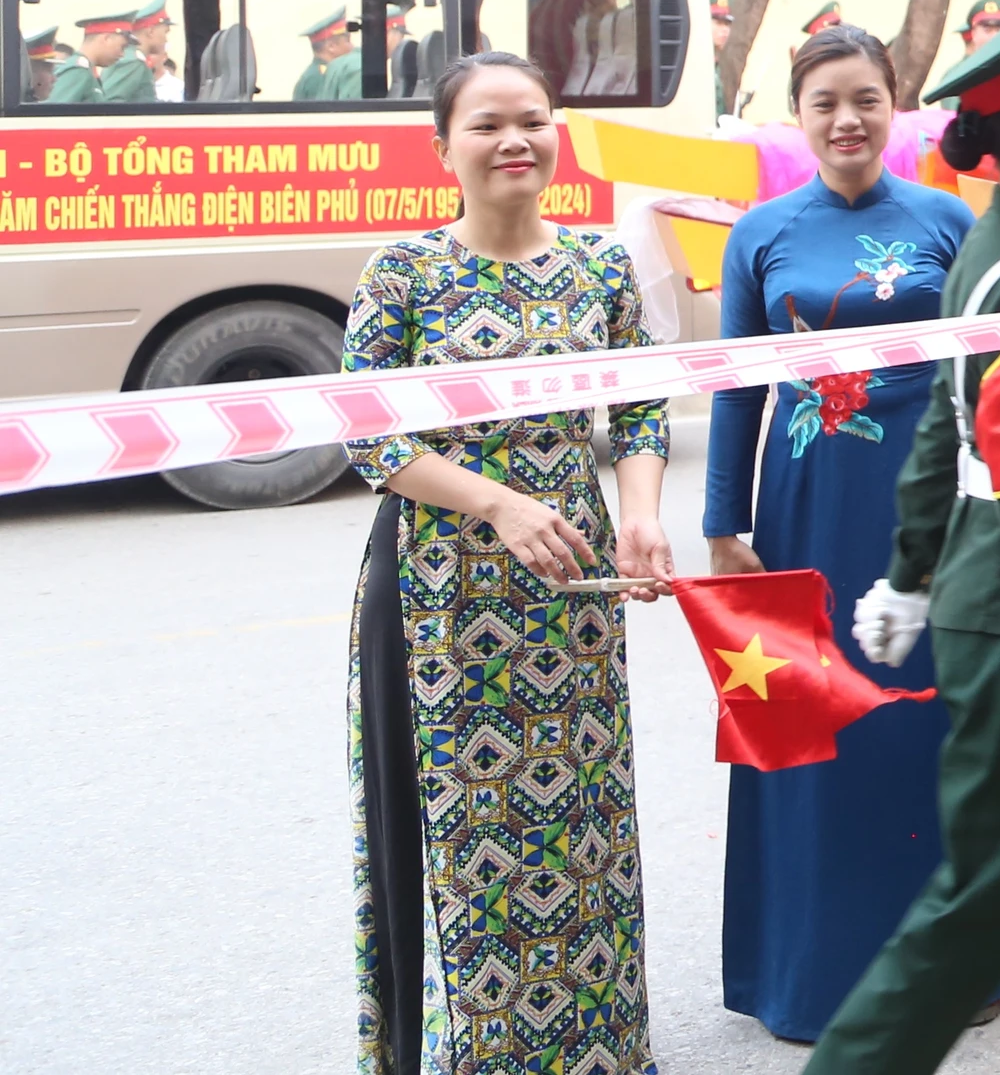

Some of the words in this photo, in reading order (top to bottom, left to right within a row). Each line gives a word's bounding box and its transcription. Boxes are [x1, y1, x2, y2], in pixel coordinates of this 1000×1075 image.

[45, 142, 92, 183] BỘ
[103, 136, 194, 176] TỔNG
[204, 144, 297, 174] THAM
[308, 140, 380, 172] MƯU
[0, 190, 37, 232] ĂM
[45, 184, 115, 230] CHIẾN
[121, 181, 196, 228] THẮNG
[202, 184, 254, 233] ĐIỆN
[260, 183, 310, 224] BIÊN
[316, 178, 359, 222] PHỦ
[365, 186, 459, 224] (07/5/195
